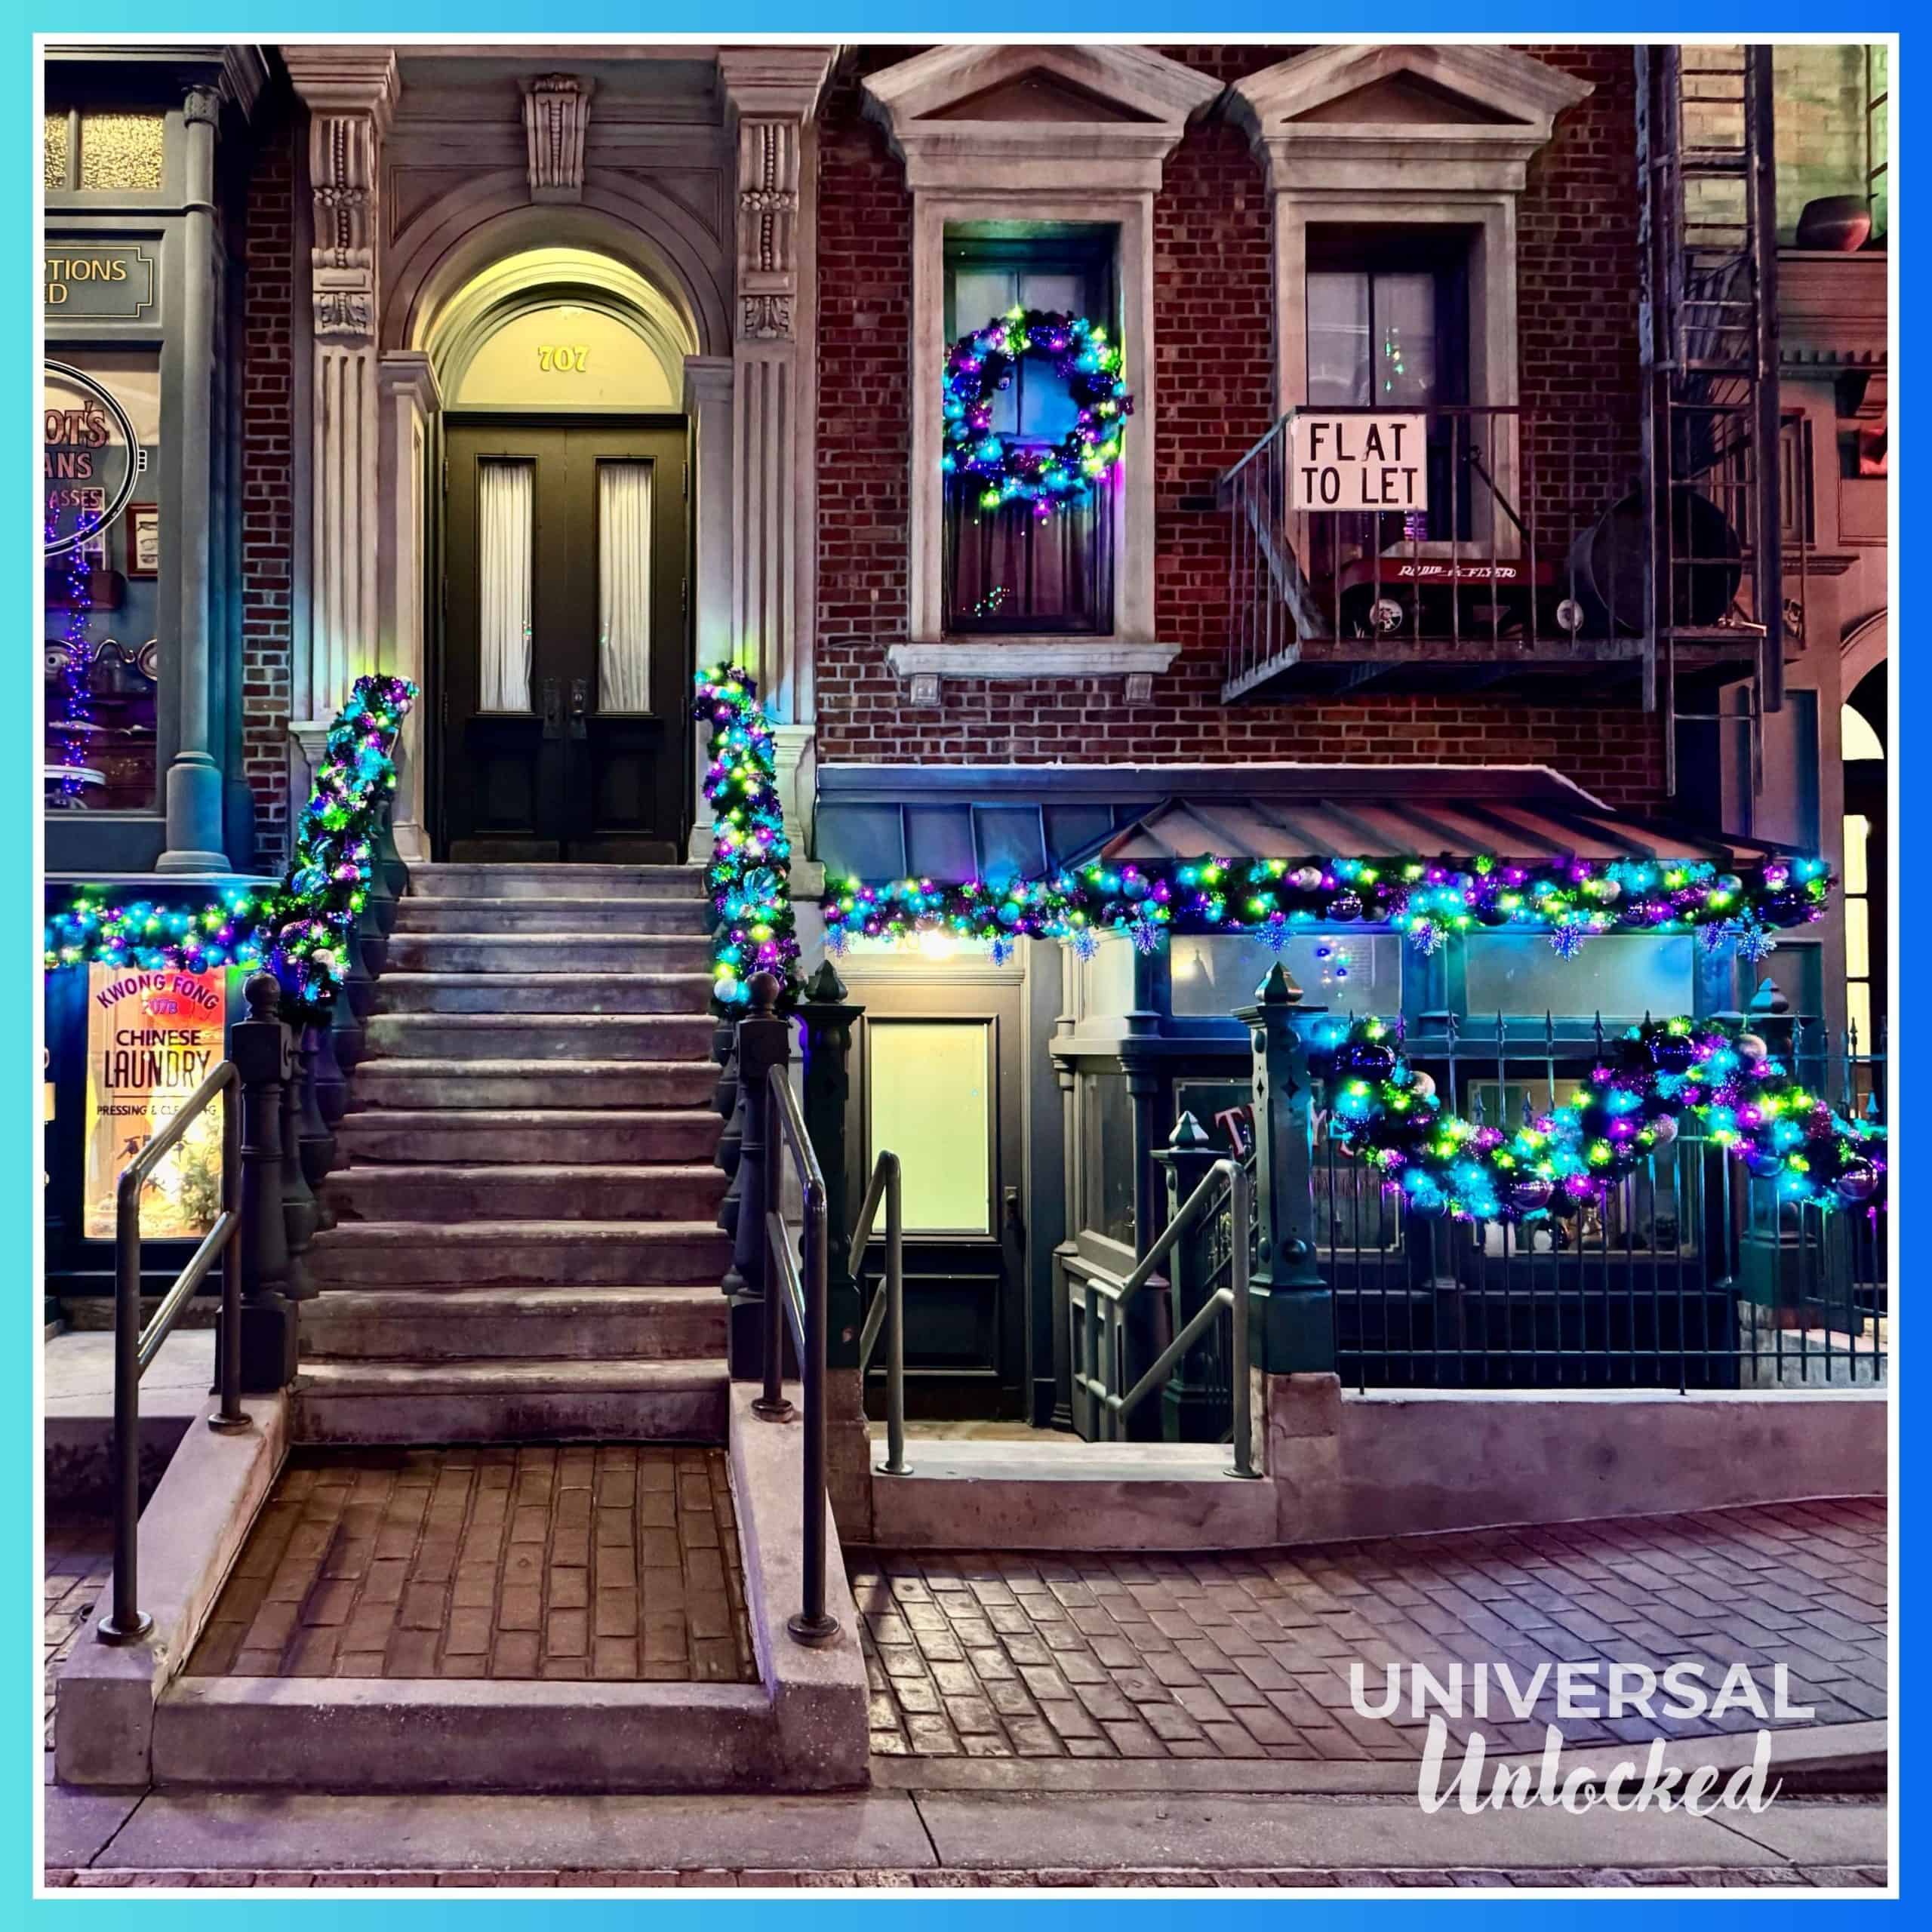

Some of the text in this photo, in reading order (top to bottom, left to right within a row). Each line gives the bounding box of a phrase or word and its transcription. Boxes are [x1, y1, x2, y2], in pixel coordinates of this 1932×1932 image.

[44, 260, 127, 281] TIONS
[44, 283, 68, 303] D
[538, 345, 589, 372] 707
[1310, 423, 1407, 461] FLAT
[1301, 466, 1418, 504] TO LET
[97, 974, 220, 1010] KWONG FONG
[116, 1029, 202, 1046] CHINESE
[104, 1050, 211, 1088] LAUNDRY
[97, 1105, 147, 1115] PRESSING
